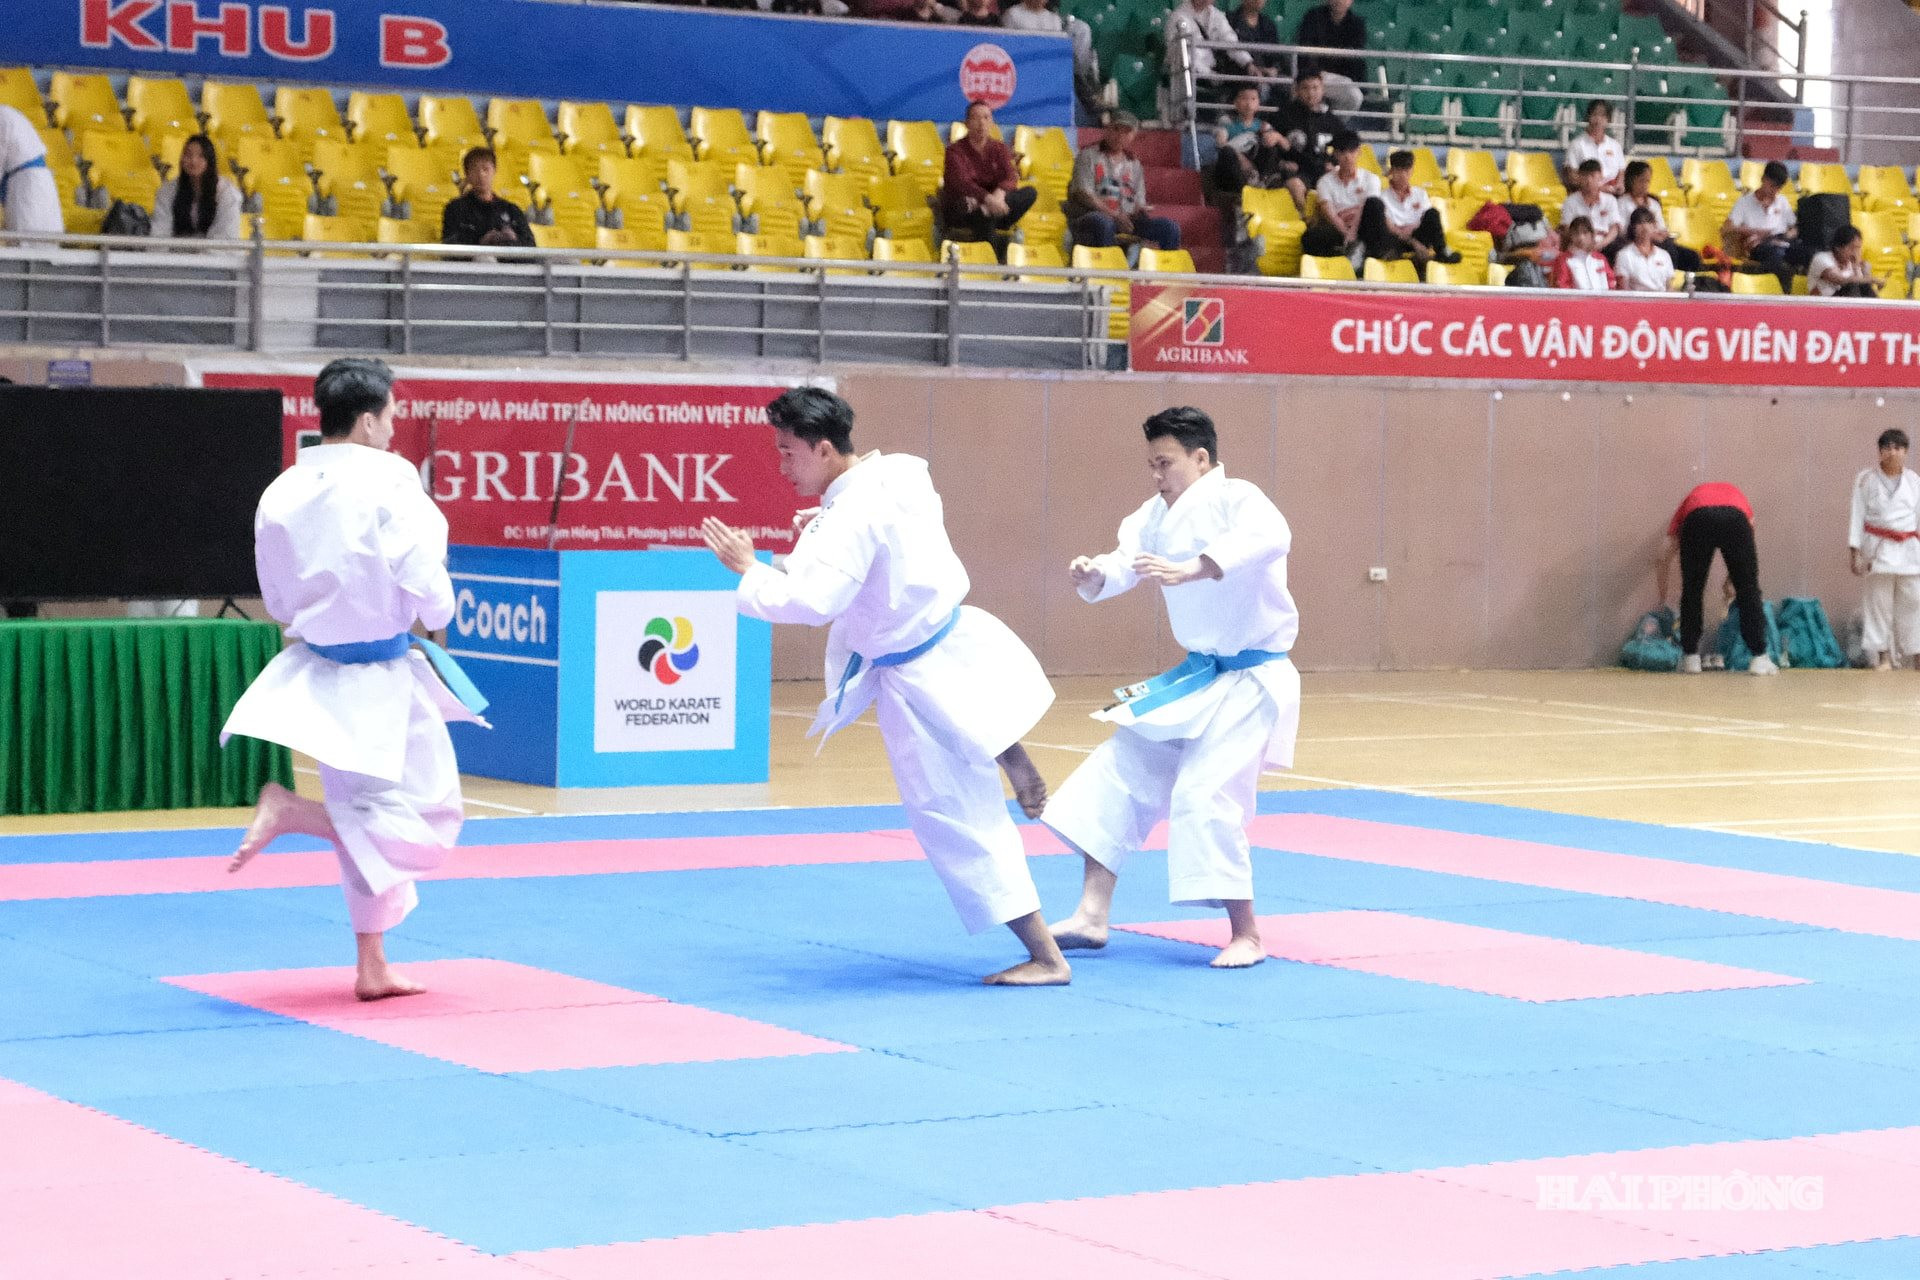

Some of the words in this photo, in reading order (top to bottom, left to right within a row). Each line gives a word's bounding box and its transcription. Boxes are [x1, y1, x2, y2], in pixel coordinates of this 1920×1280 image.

[80, 0, 335, 61] KHU
[380, 14, 451, 68] B
[1156, 346, 1249, 365] AGRIBANK
[1331, 314, 1434, 356] CHÚC
[1440, 316, 1513, 358] CÁC
[1520, 317, 1594, 368] VẬN
[1602, 319, 1709, 369] ĐỘNG
[1715, 321, 1798, 363] VIÊN
[1805, 331, 1876, 373] ĐẠT
[1880, 332, 1920, 366] TH
[478, 398, 502, 420] VÀ
[505, 399, 549, 421] PHÁT
[605, 400, 654, 423] NÔNG
[656, 401, 703, 424] THÔN
[705, 402, 742, 429] VIỆT
[744, 405, 770, 425] NA
[420, 450, 738, 502] GRIBANK
[455, 588, 548, 644] Coach
[615, 698, 666, 711] WORLD
[669, 697, 721, 711] KARATE
[625, 712, 710, 727] FEDERATION
